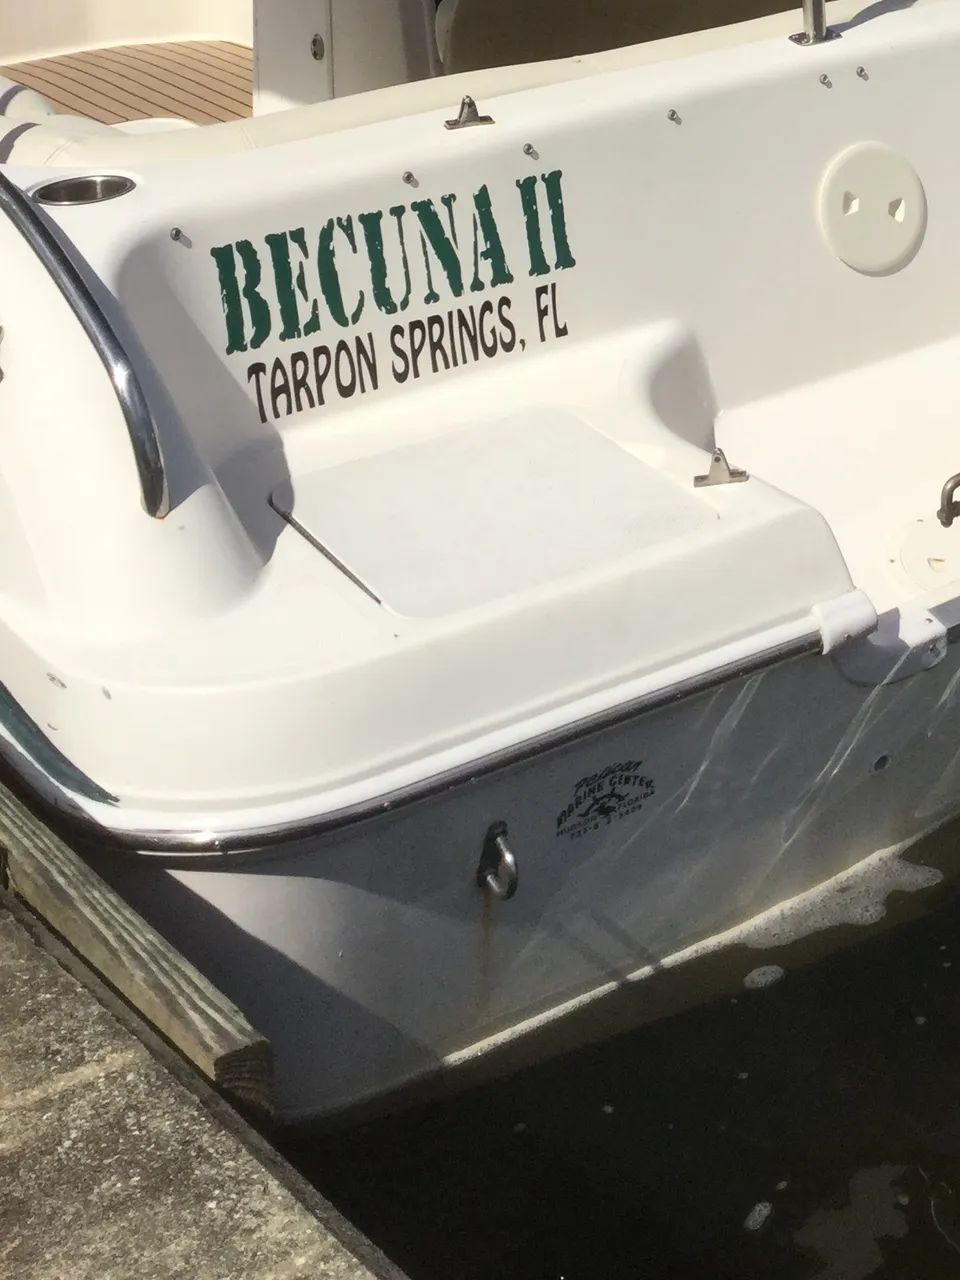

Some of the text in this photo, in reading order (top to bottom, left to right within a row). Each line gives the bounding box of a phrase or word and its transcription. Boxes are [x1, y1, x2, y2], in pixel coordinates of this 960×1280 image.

[210, 169, 576, 355] BECUNA II
[247, 282, 569, 423] TARPON SPRINGS, FL
[556, 774, 655, 829] MARINE CENTER
